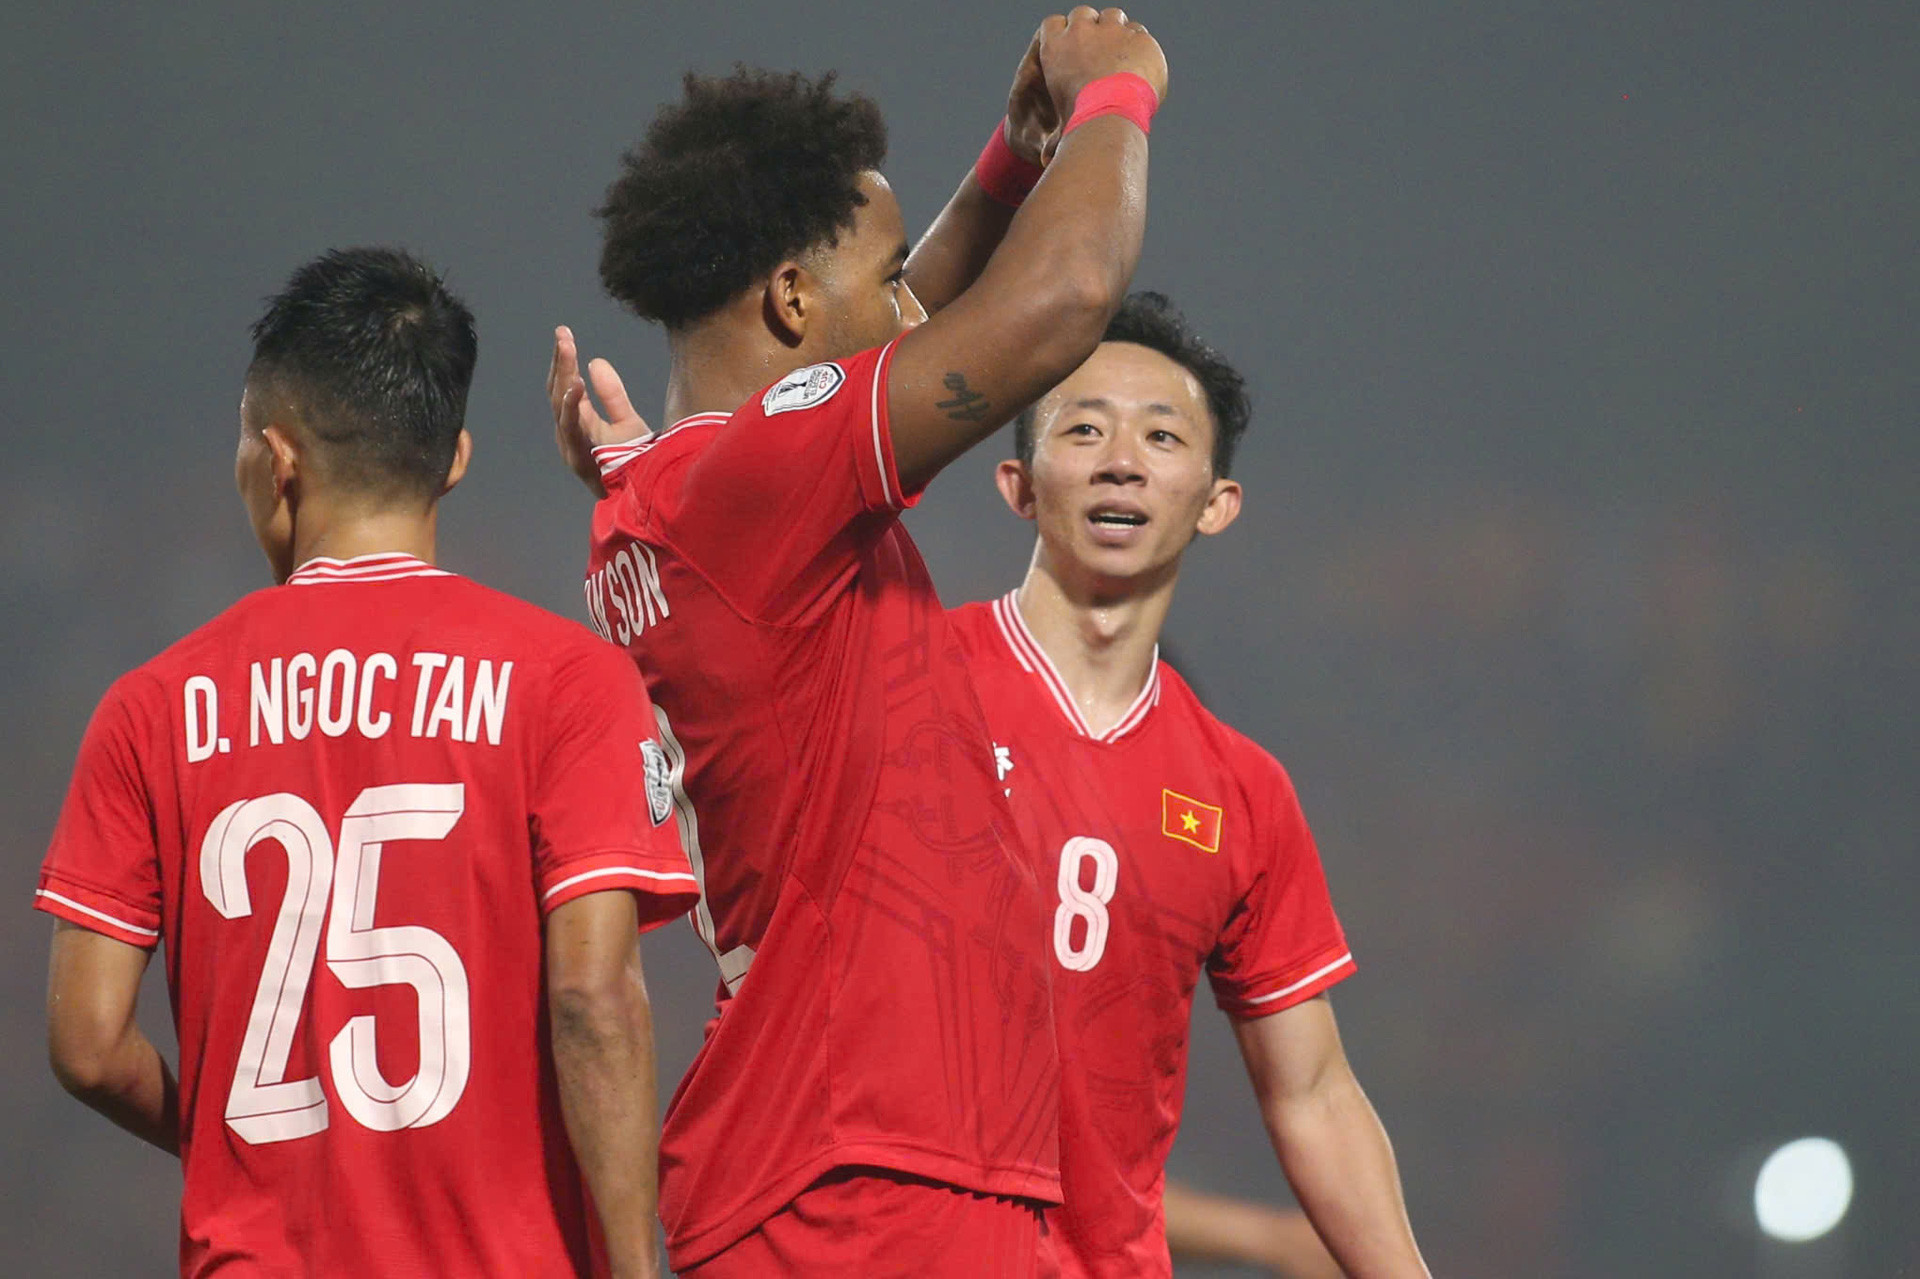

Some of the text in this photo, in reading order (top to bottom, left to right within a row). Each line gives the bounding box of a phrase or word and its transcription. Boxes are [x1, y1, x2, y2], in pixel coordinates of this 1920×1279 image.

[605, 540, 670, 647] SON
[184, 648, 513, 762] D. NGOC TAN
[199, 782, 471, 1145] 25
[1053, 836, 1119, 972] 8
